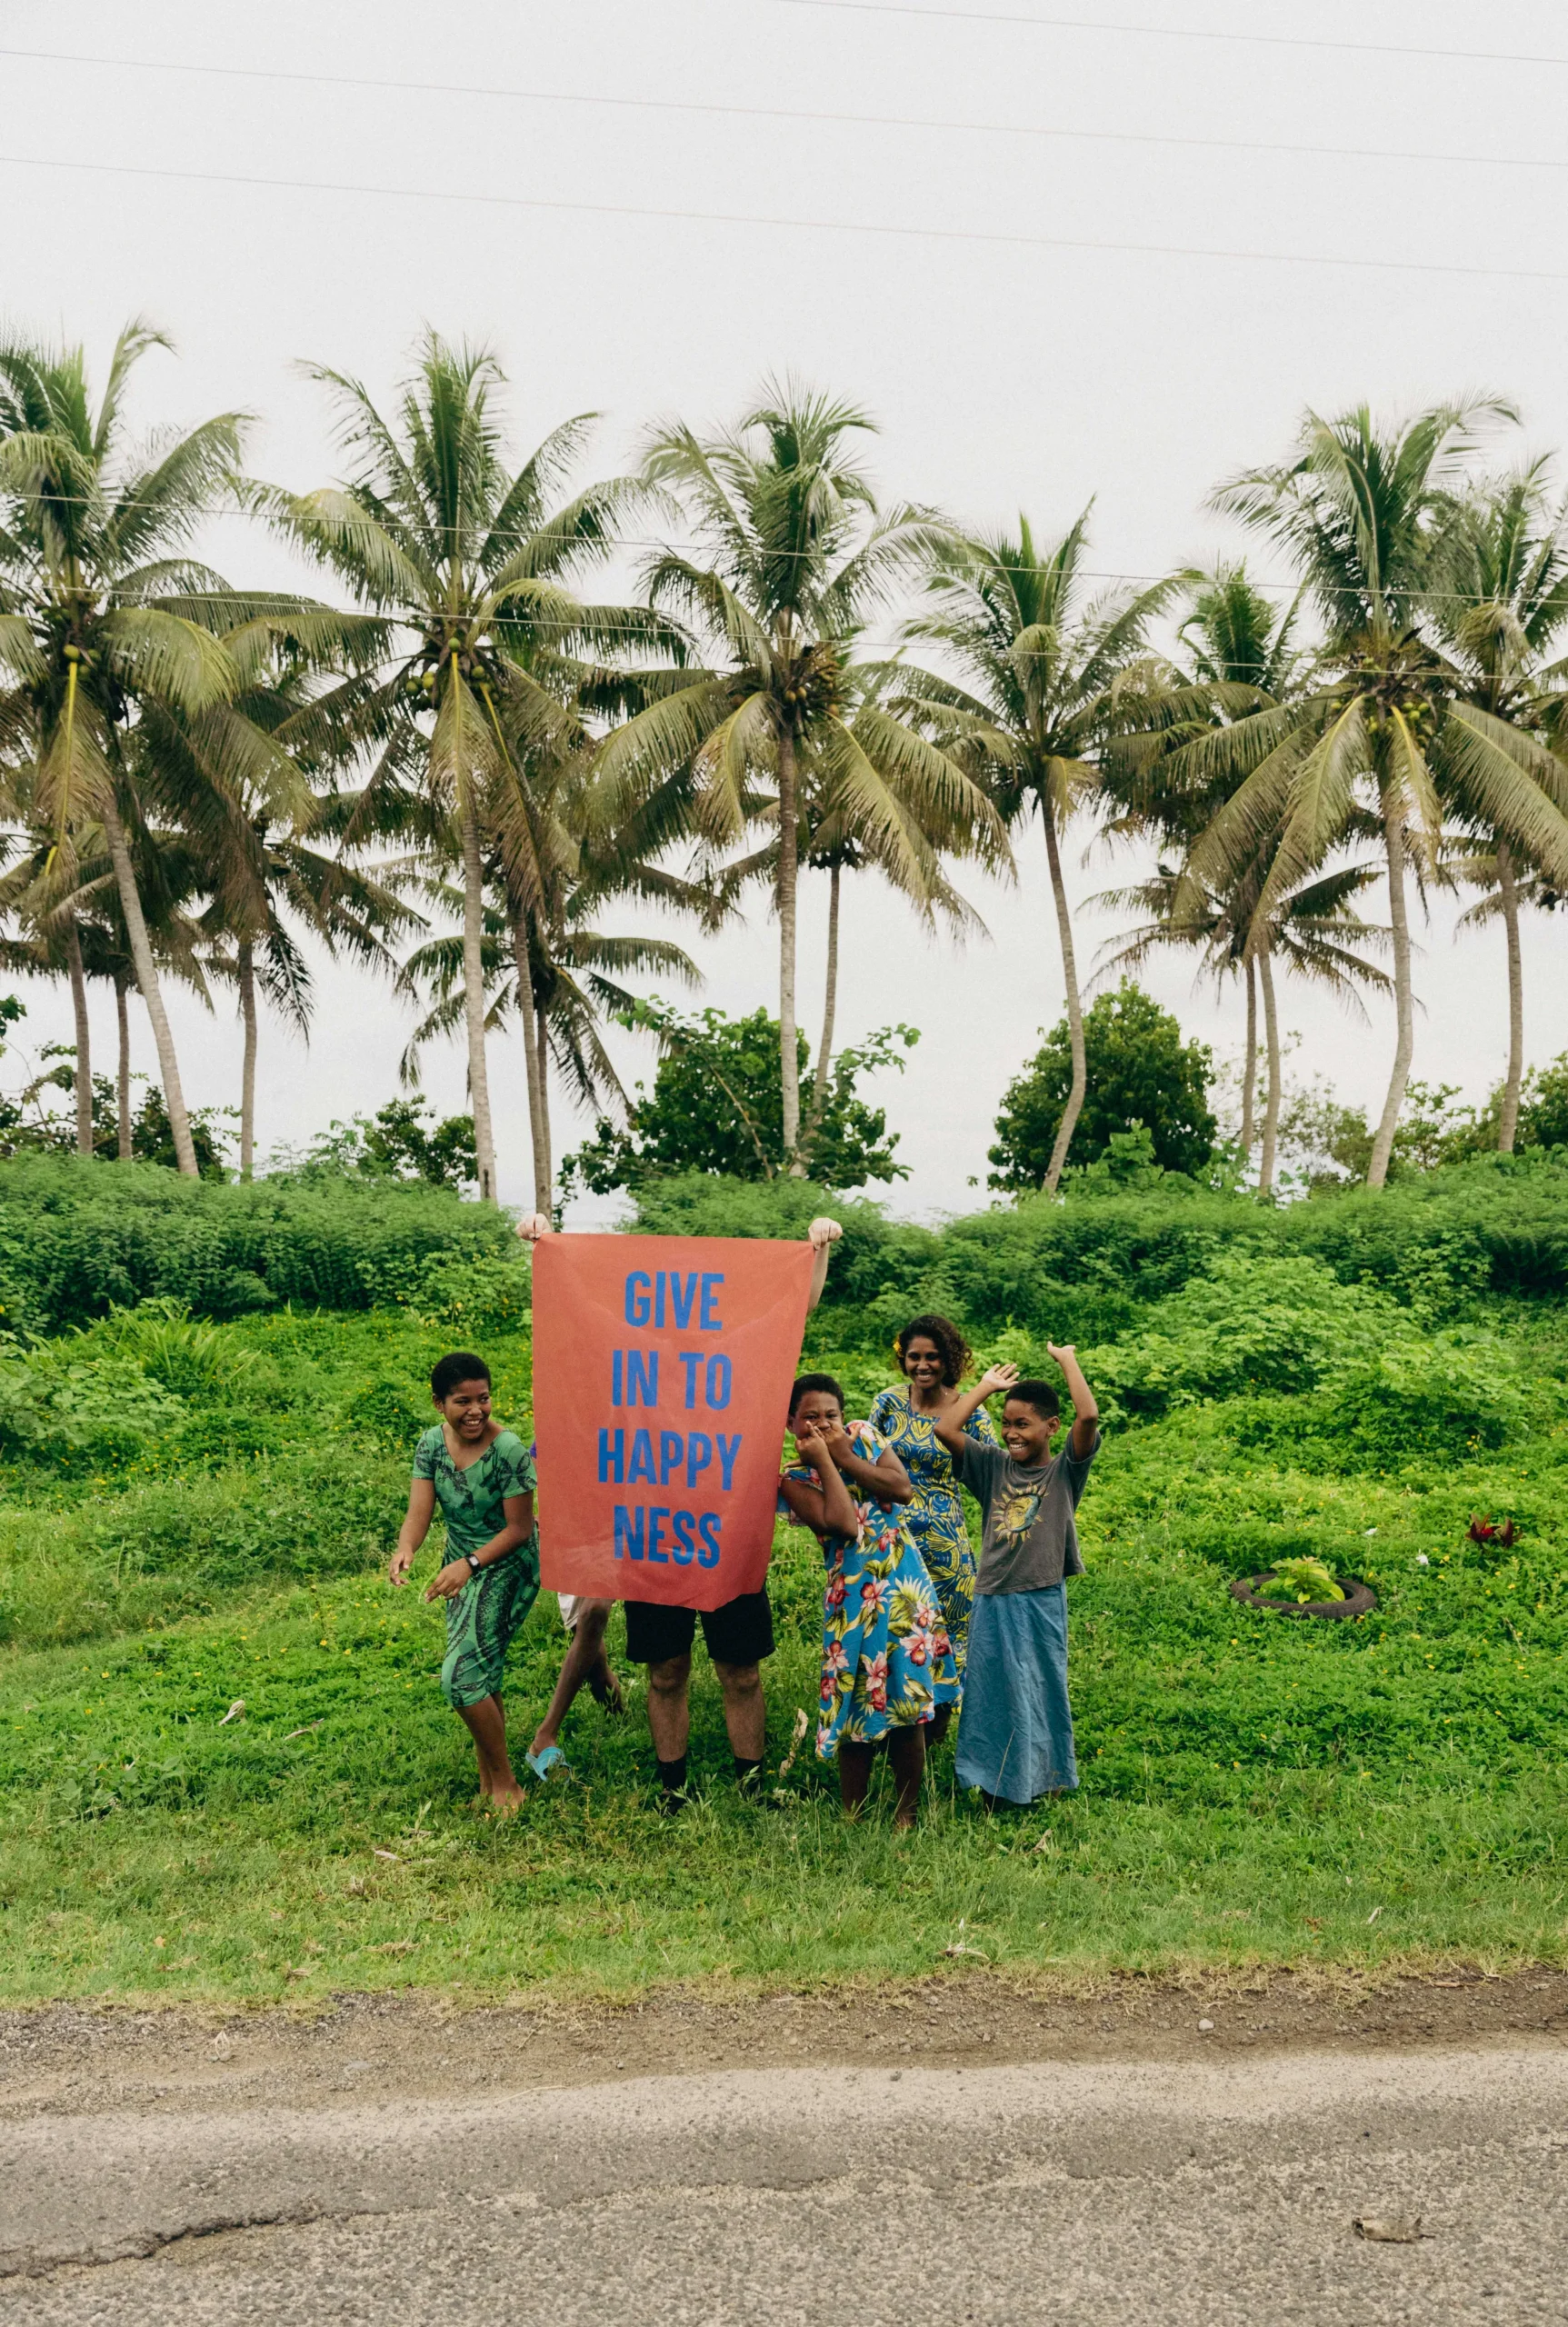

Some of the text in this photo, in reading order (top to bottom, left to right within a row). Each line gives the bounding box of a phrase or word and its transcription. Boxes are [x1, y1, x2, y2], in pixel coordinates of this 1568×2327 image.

[625, 1271, 724, 1329] GIVE
[613, 1350, 732, 1410] IN TO
[598, 1428, 742, 1491] HAPPY
[614, 1505, 721, 1569] NESS
